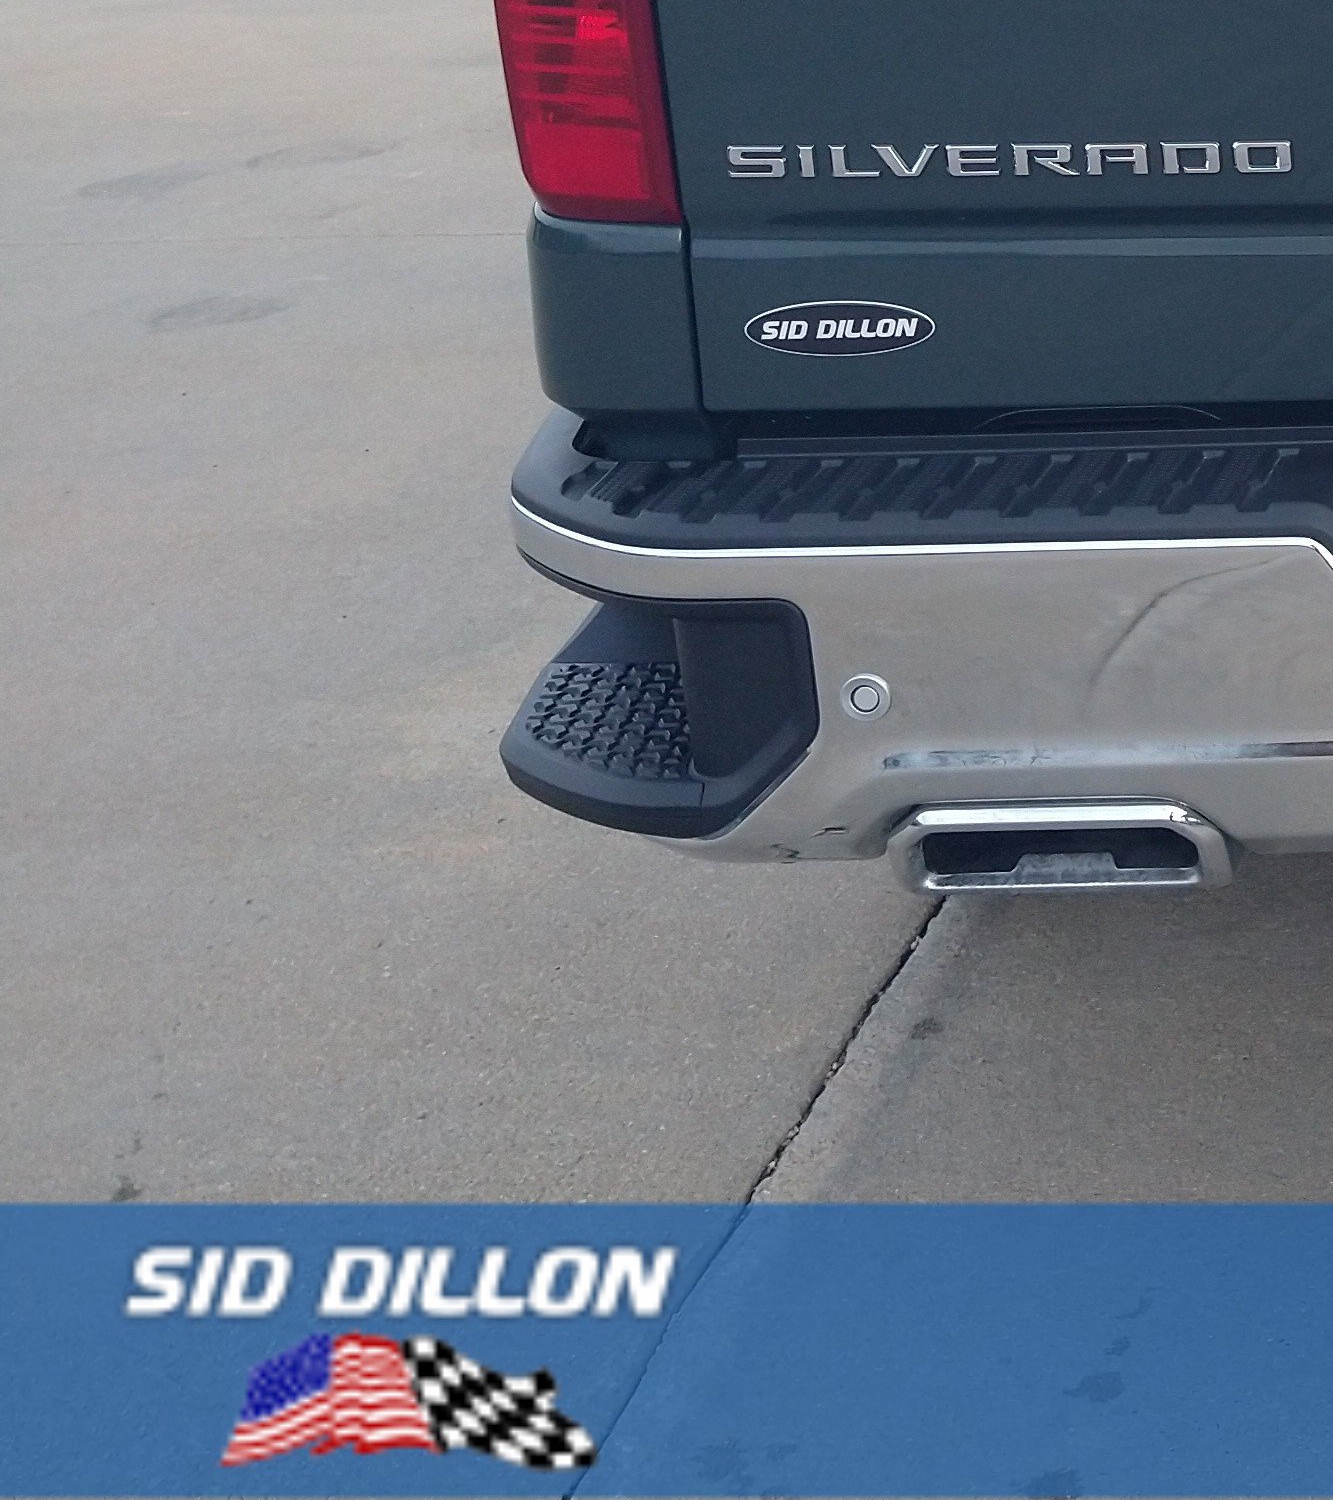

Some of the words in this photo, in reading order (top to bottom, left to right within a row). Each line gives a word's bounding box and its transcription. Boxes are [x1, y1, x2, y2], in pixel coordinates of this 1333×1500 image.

[727, 140, 1291, 178] SILVERADO
[760, 318, 808, 340] SID
[815, 316, 918, 340] DILLON
